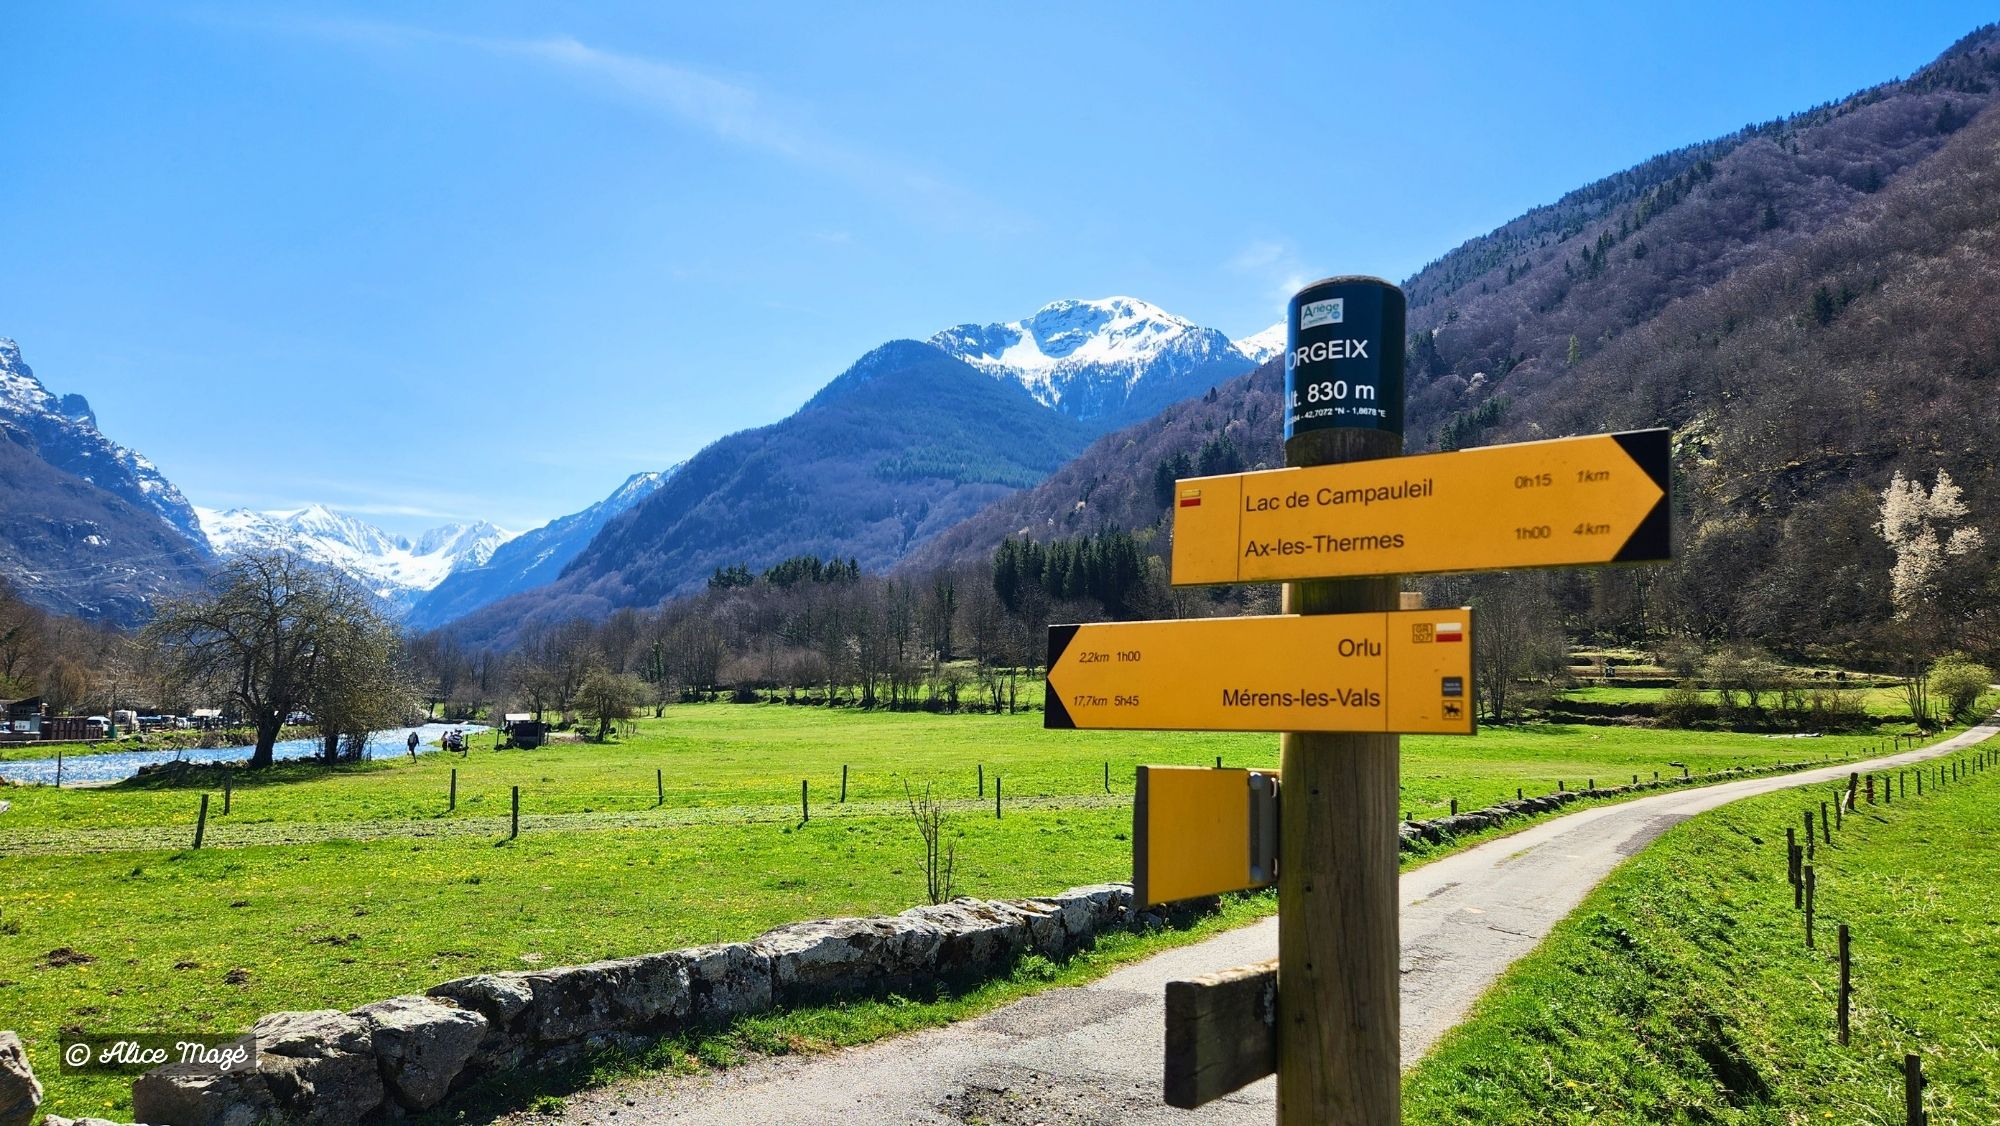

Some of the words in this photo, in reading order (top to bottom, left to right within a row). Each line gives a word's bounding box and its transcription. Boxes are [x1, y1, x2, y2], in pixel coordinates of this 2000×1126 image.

[1303, 303, 1340, 320] Ariège
[1307, 380, 1347, 403] 830
[1355, 384, 1375, 400] m
[1514, 473, 1552, 489] 0h15
[1576, 468, 1610, 483] 1km
[1246, 496, 1280, 512] Lac
[1285, 491, 1309, 508] de
[1316, 478, 1433, 506] Campauleil
[1515, 525, 1551, 540] 1h00
[1573, 522, 1610, 536] 4km
[1245, 533, 1404, 557] Ax-les-Thermes
[1338, 638, 1381, 657] Orlu
[1079, 651, 1110, 664] 2,2km
[1117, 651, 1141, 662] 1h00
[1073, 695, 1108, 707] 17,7km
[1114, 695, 1139, 706] 5h45
[1222, 688, 1380, 707] Mérens-les-Vals
